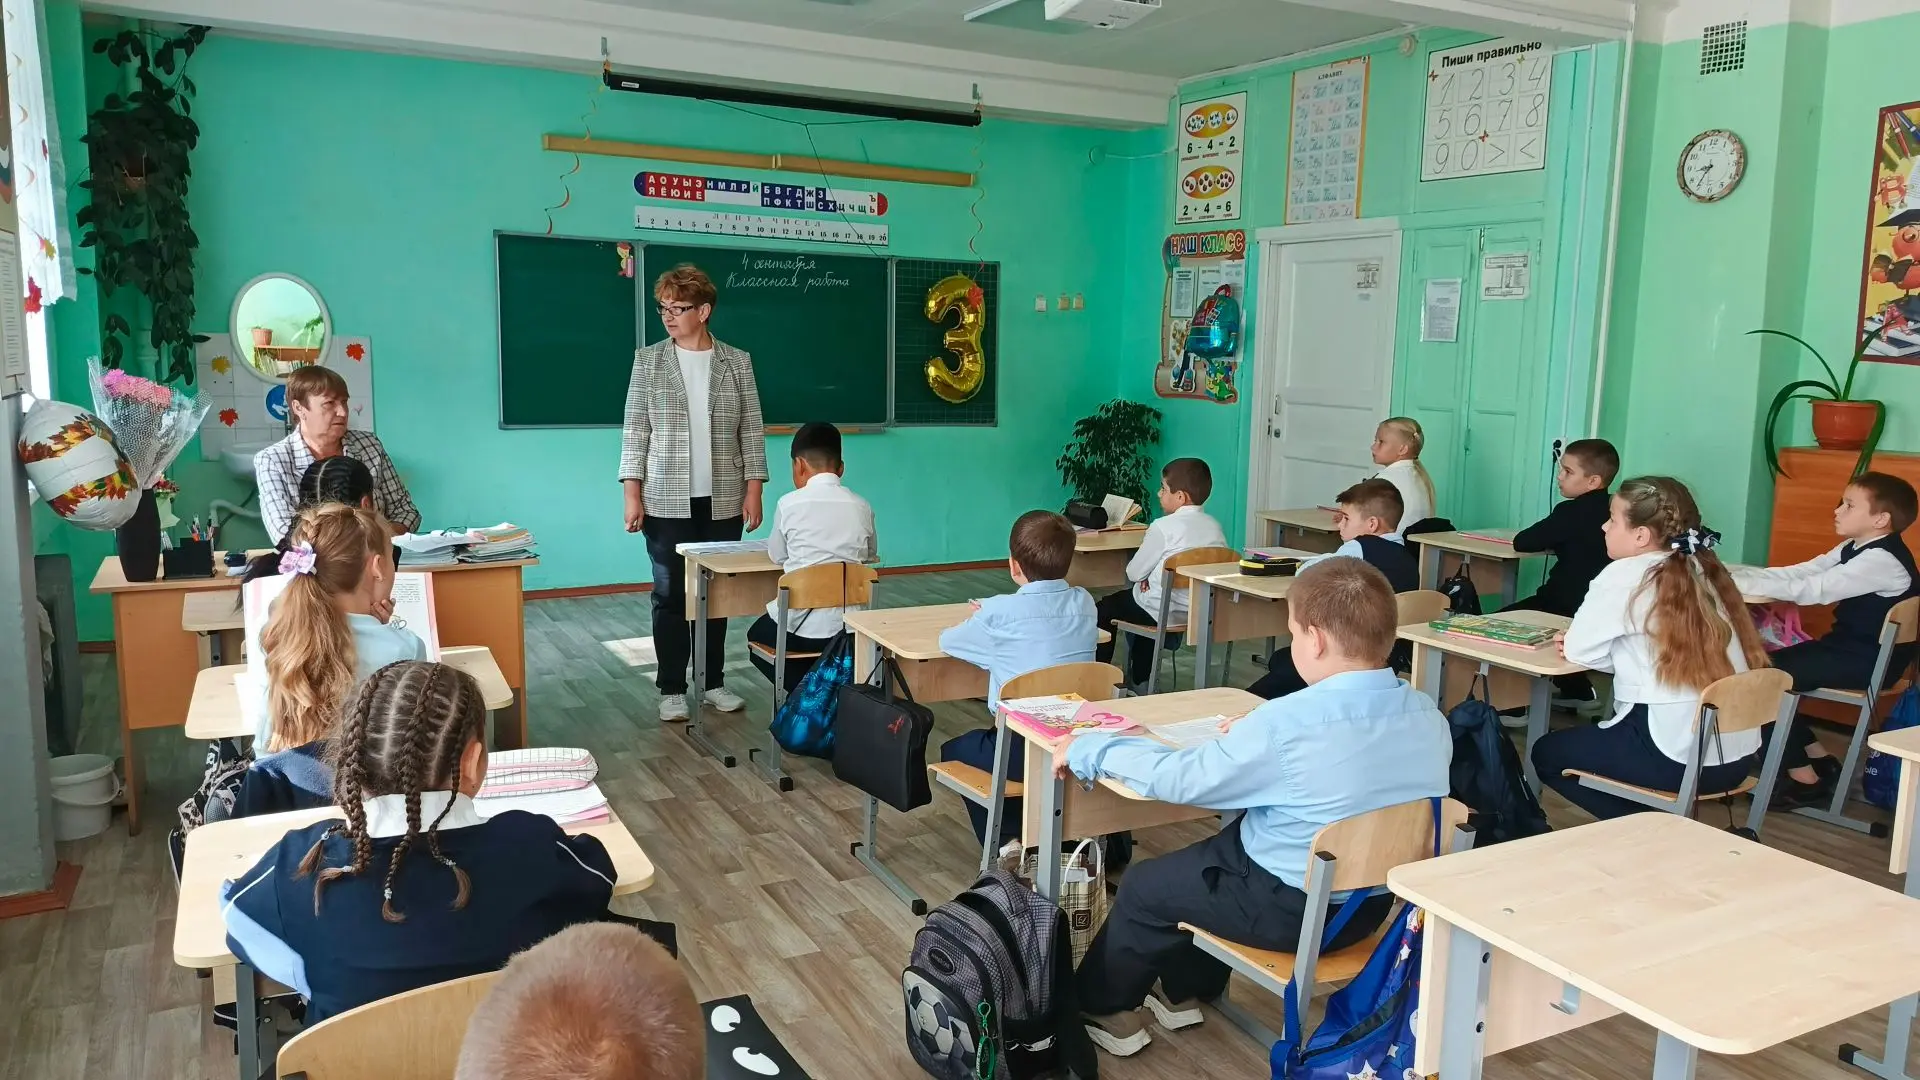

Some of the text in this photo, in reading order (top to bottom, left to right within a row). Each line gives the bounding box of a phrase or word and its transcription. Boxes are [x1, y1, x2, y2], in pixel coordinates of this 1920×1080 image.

[1442, 41, 1542, 68] Пиши правильно
[1441, 58, 1546, 104] 1 2 3 4
[1435, 94, 1544, 139] 5 6 7 8
[1187, 142, 1193, 154] 6
[1207, 139, 1213, 150] 4
[1229, 136, 1235, 147] 2
[1434, 143, 1449, 174] 9
[648, 175, 655, 184] А
[672, 177, 678, 186] У
[683, 179, 691, 187] Ы
[696, 180, 702, 188] Э
[707, 181, 714, 189] Н
[718, 182, 726, 190] М
[730, 182, 737, 191] Л
[741, 183, 747, 192] Р
[752, 183, 759, 193] Й
[763, 186, 770, 194] Б
[786, 188, 792, 196] Г
[796, 189, 803, 198] Д
[806, 189, 814, 198] Ж
[648, 187, 655, 195] Я
[661, 188, 667, 196] Ё
[671, 189, 680, 197] Ю
[684, 191, 690, 199] И
[696, 191, 702, 199] Е
[764, 197, 770, 205] П
[773, 198, 781, 206] Ф
[786, 199, 791, 207] К
[797, 199, 802, 207] Т
[806, 200, 814, 208] Ш
[818, 201, 823, 209] С
[838, 203, 845, 212] Ц
[849, 204, 855, 212] Ч
[858, 205, 866, 214] Щ
[1183, 205, 1188, 215] 2
[1204, 203, 1210, 214] 4
[1225, 201, 1231, 212] 6
[1171, 231, 1244, 255] НАШ КЛАСС
[742, 252, 816, 277] 4 сентября
[725, 272, 850, 293] Классная работа
[924, 272, 986, 404] 3
[1092, 712, 1124, 725] 3
